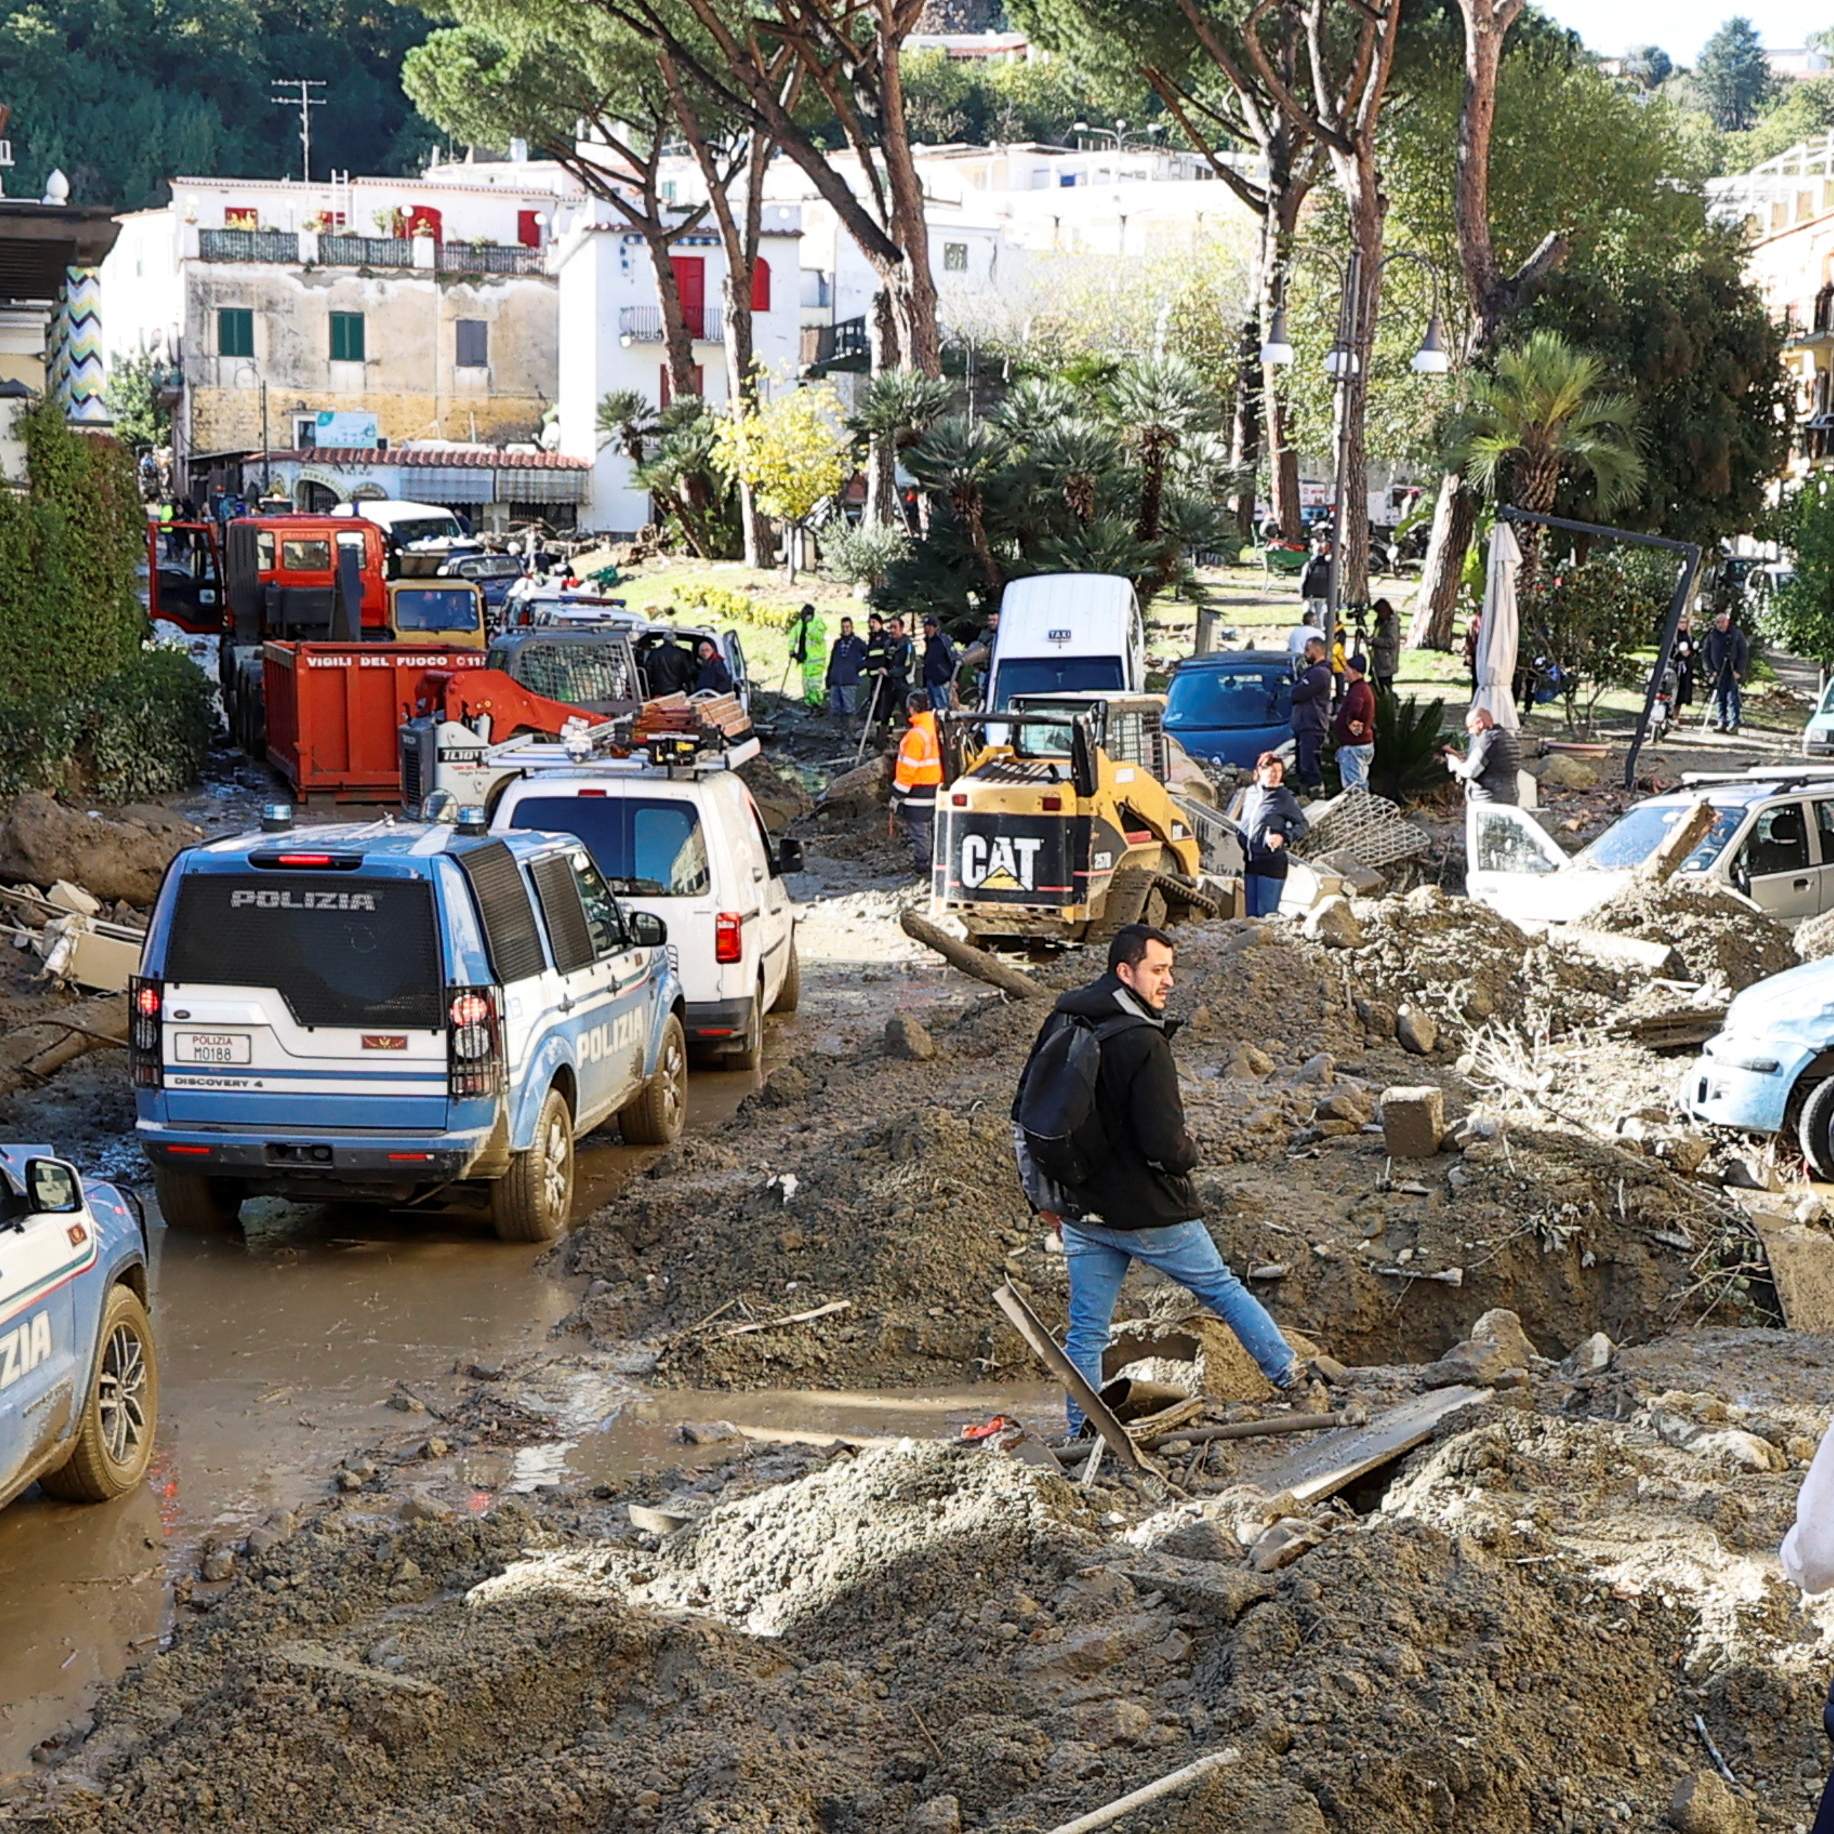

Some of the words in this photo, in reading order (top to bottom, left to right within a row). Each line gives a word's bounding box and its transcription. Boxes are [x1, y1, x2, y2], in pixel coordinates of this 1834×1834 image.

[1048, 630, 1071, 640] TAXI
[306, 656, 353, 667] VIGILI
[360, 656, 390, 667] DEL
[396, 656, 449, 667] FUOCO
[961, 834, 1042, 892] CAT
[230, 890, 377, 911] POLIZIA
[192, 1035, 233, 1047] POLIZIA
[576, 1005, 645, 1070] POLIZIA
[194, 1047, 232, 1061] M0188
[174, 1077, 248, 1088] DISCOVERY
[254, 1080, 263, 1088] 4
